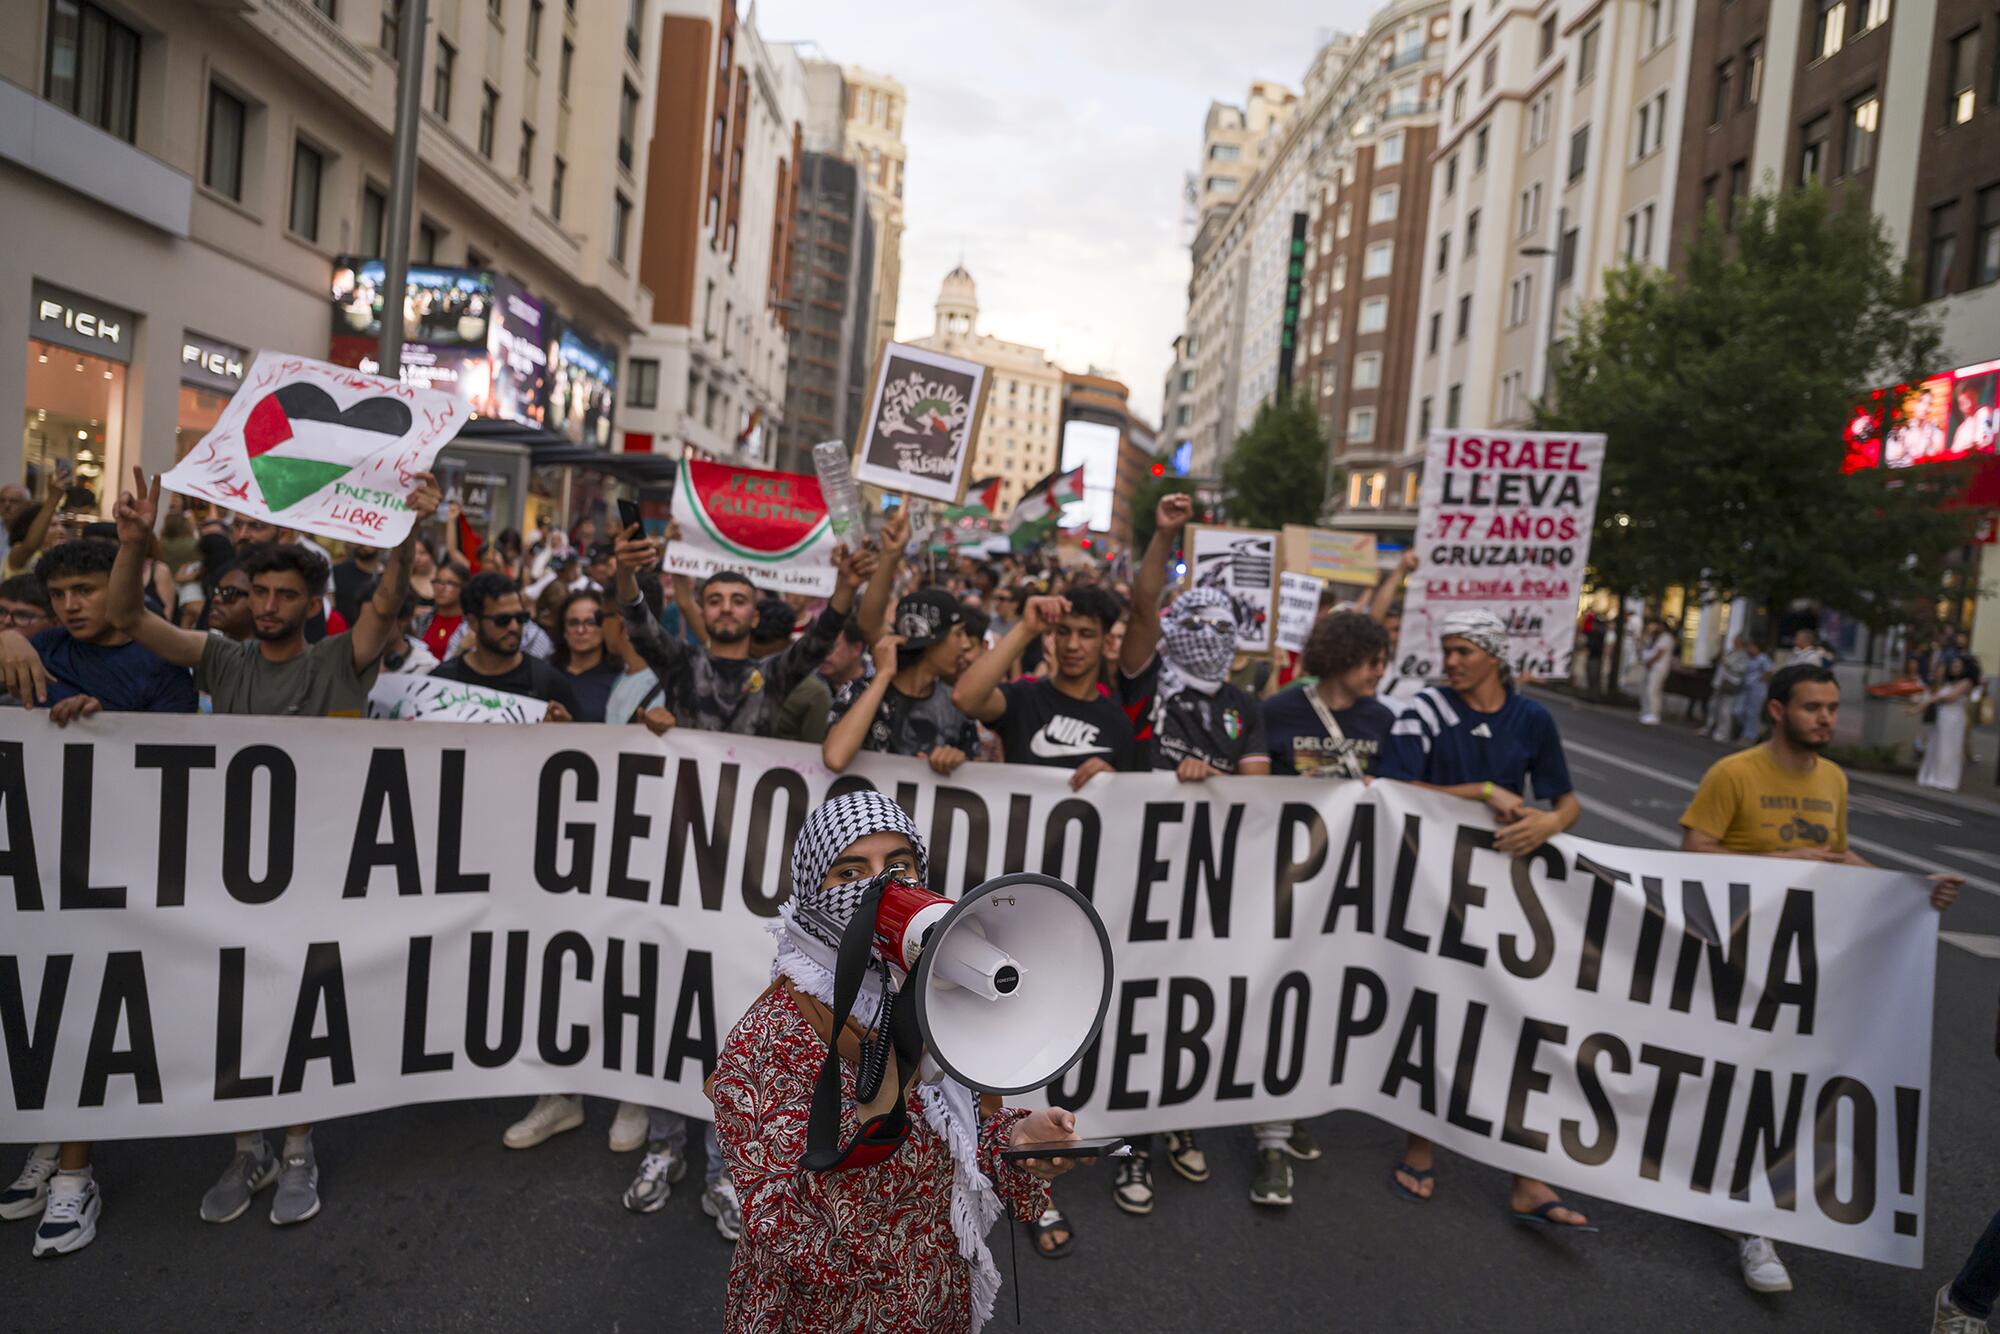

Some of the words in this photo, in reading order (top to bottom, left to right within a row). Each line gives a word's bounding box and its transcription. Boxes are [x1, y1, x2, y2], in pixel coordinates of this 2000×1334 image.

[1446, 437, 1588, 472] ISRAEL
[731, 473, 794, 499] FREE
[1442, 472, 1582, 508] LLEVA
[1438, 514, 1476, 540] 77
[1486, 510, 1577, 541] AÑOS
[1431, 545, 1575, 567] CRUZANDO
[1425, 580, 1451, 595] LA
[1520, 580, 1570, 598] ROJA
[1046, 714, 1100, 747] NIKE
[0, 741, 296, 910] ALTO
[343, 748, 490, 899] AL
[1128, 801, 1246, 942] EN
[1273, 802, 1818, 1035] PALESTINA
[214, 942, 356, 1100] LA
[401, 930, 718, 1084] LUCHA
[1330, 966, 1921, 1237] PALESTINO!
